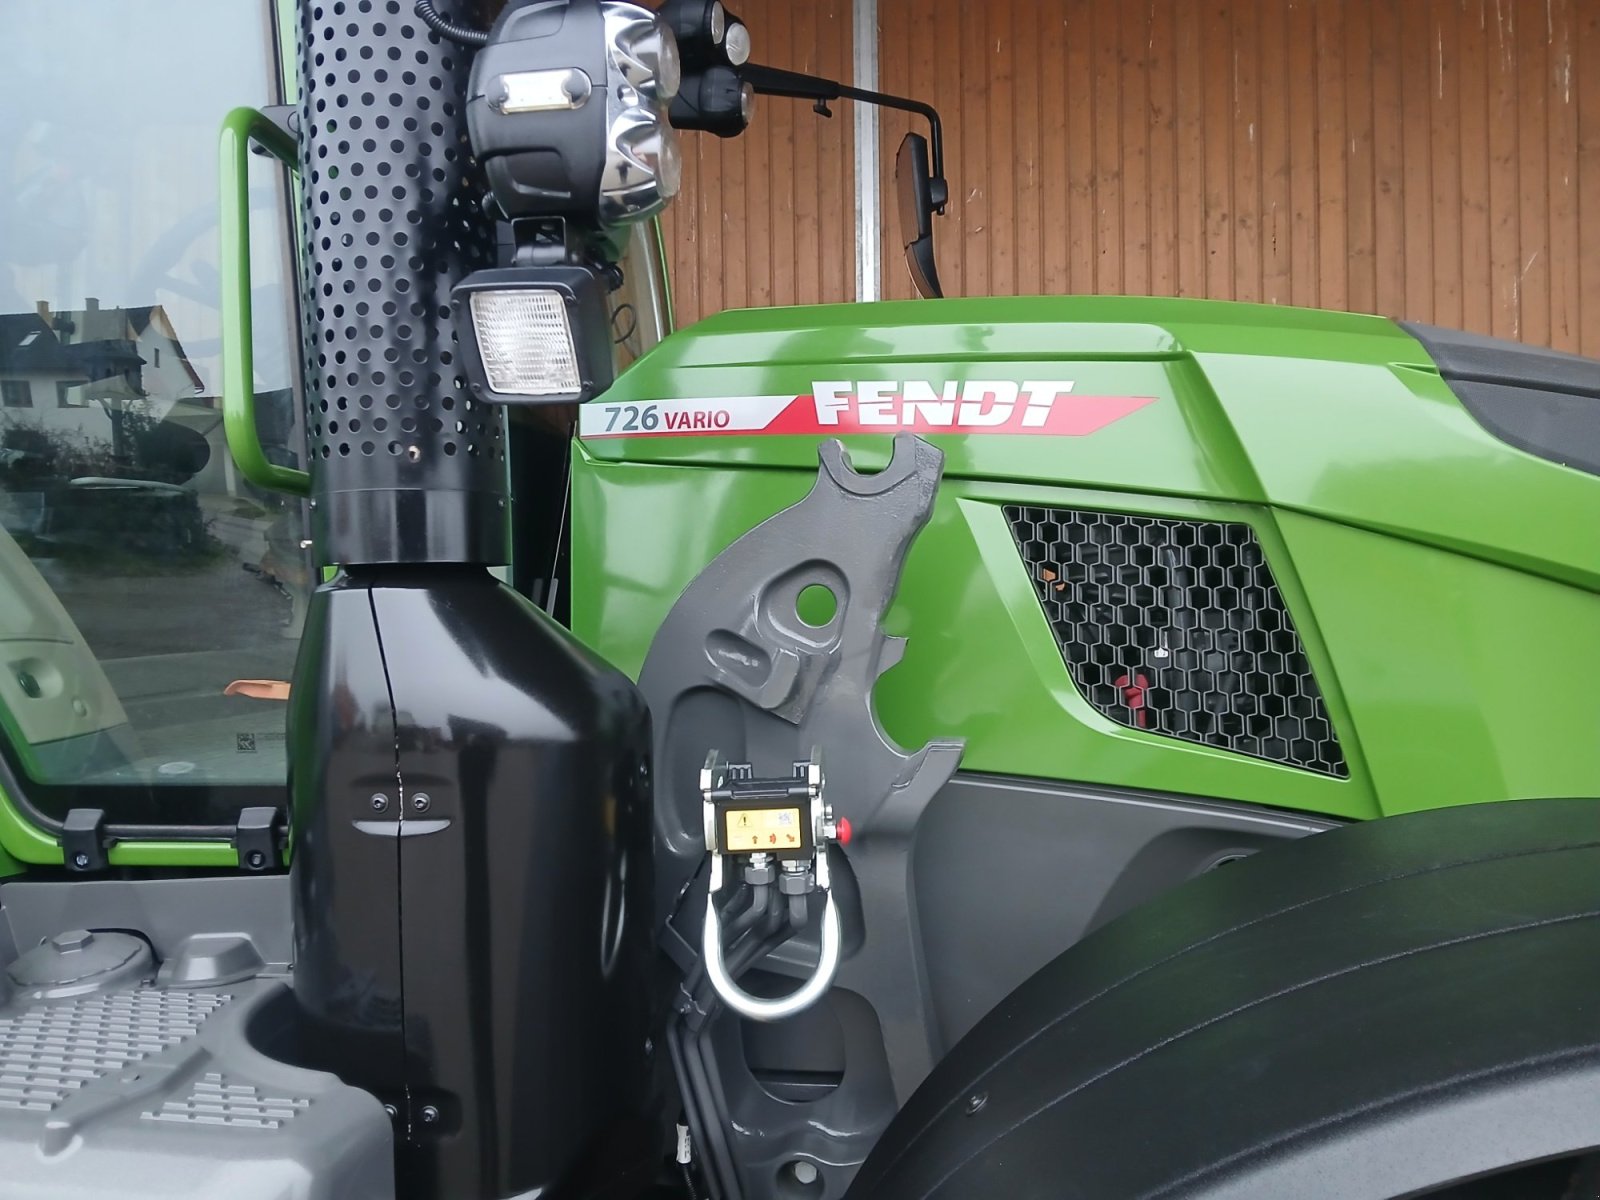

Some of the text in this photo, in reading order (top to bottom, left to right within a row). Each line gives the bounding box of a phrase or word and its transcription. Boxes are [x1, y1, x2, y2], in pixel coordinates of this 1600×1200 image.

[604, 405, 730, 432] 726 VARIO
[811, 380, 1075, 427] FENDT
